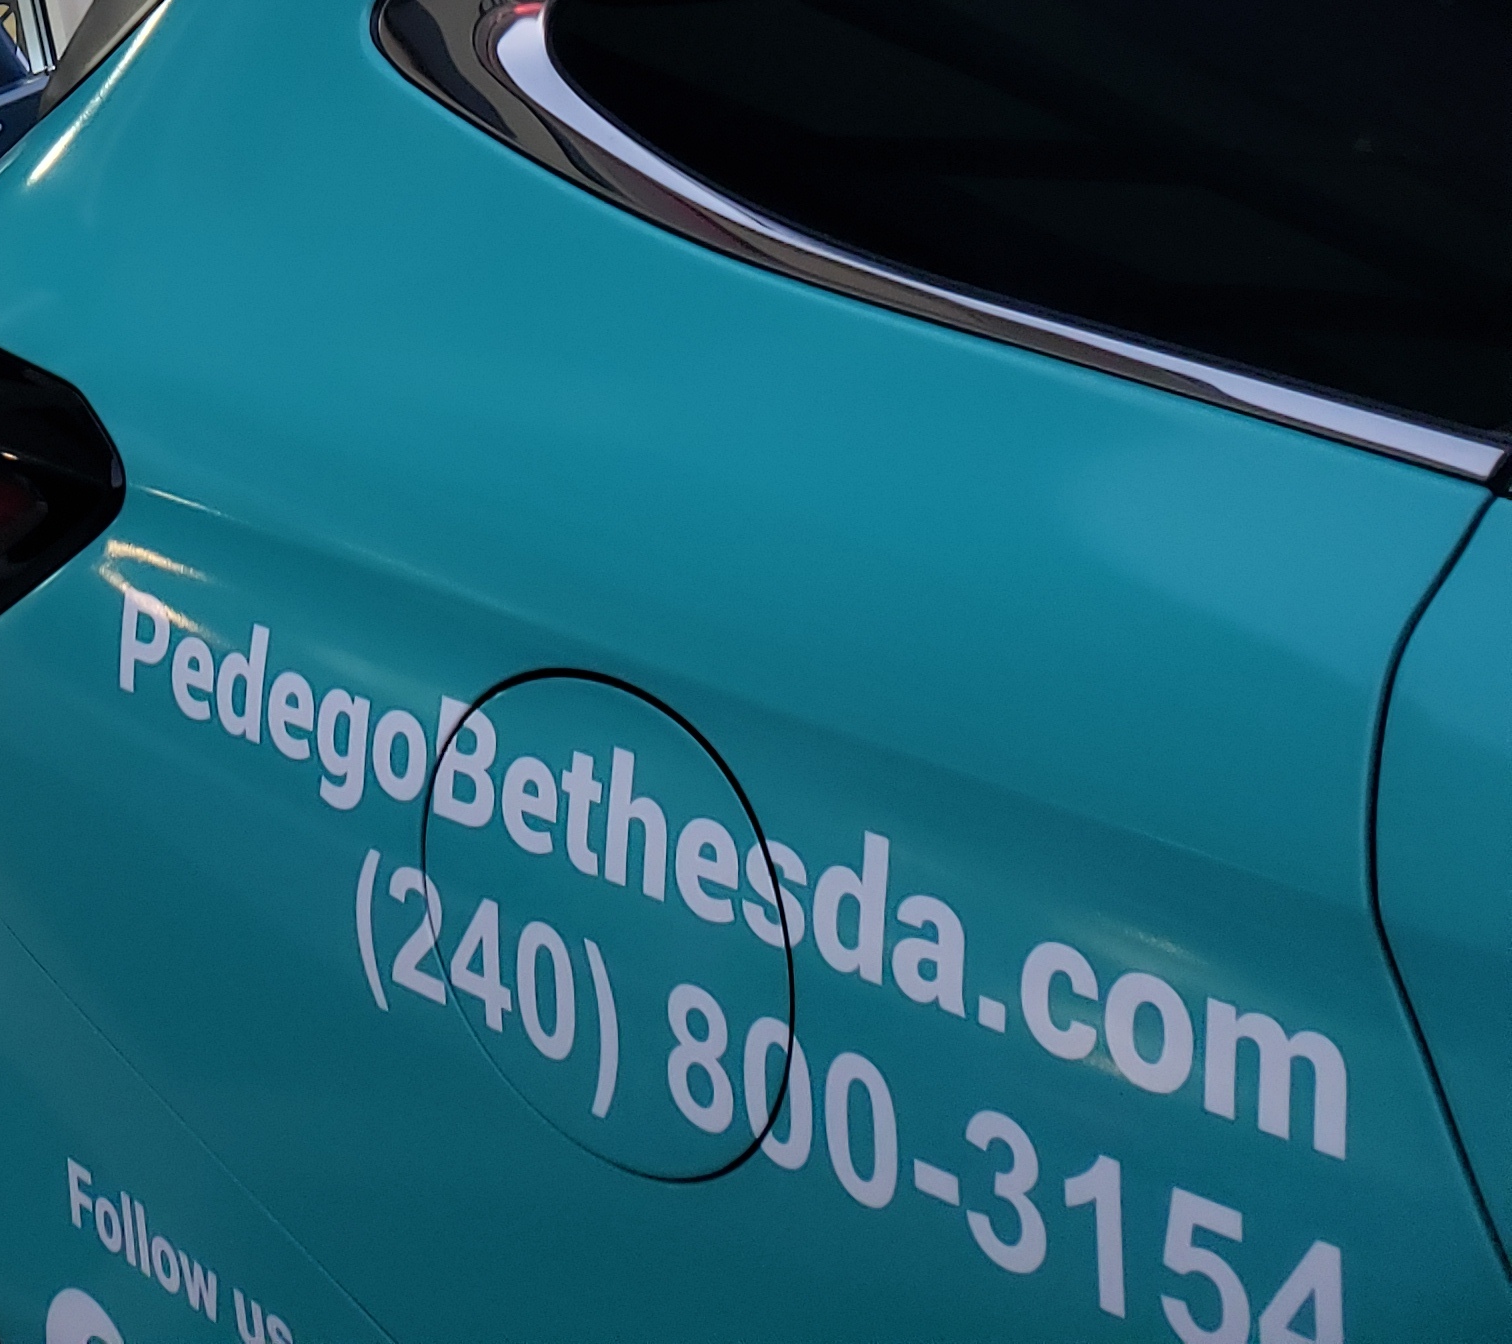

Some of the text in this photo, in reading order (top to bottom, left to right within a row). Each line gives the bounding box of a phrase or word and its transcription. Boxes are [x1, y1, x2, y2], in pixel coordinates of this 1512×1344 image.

[116, 588, 1349, 1162] PedegoBethesda.com
[354, 848, 1346, 1344] (240) 800-3154
[67, 1156, 294, 1344] Follow us
